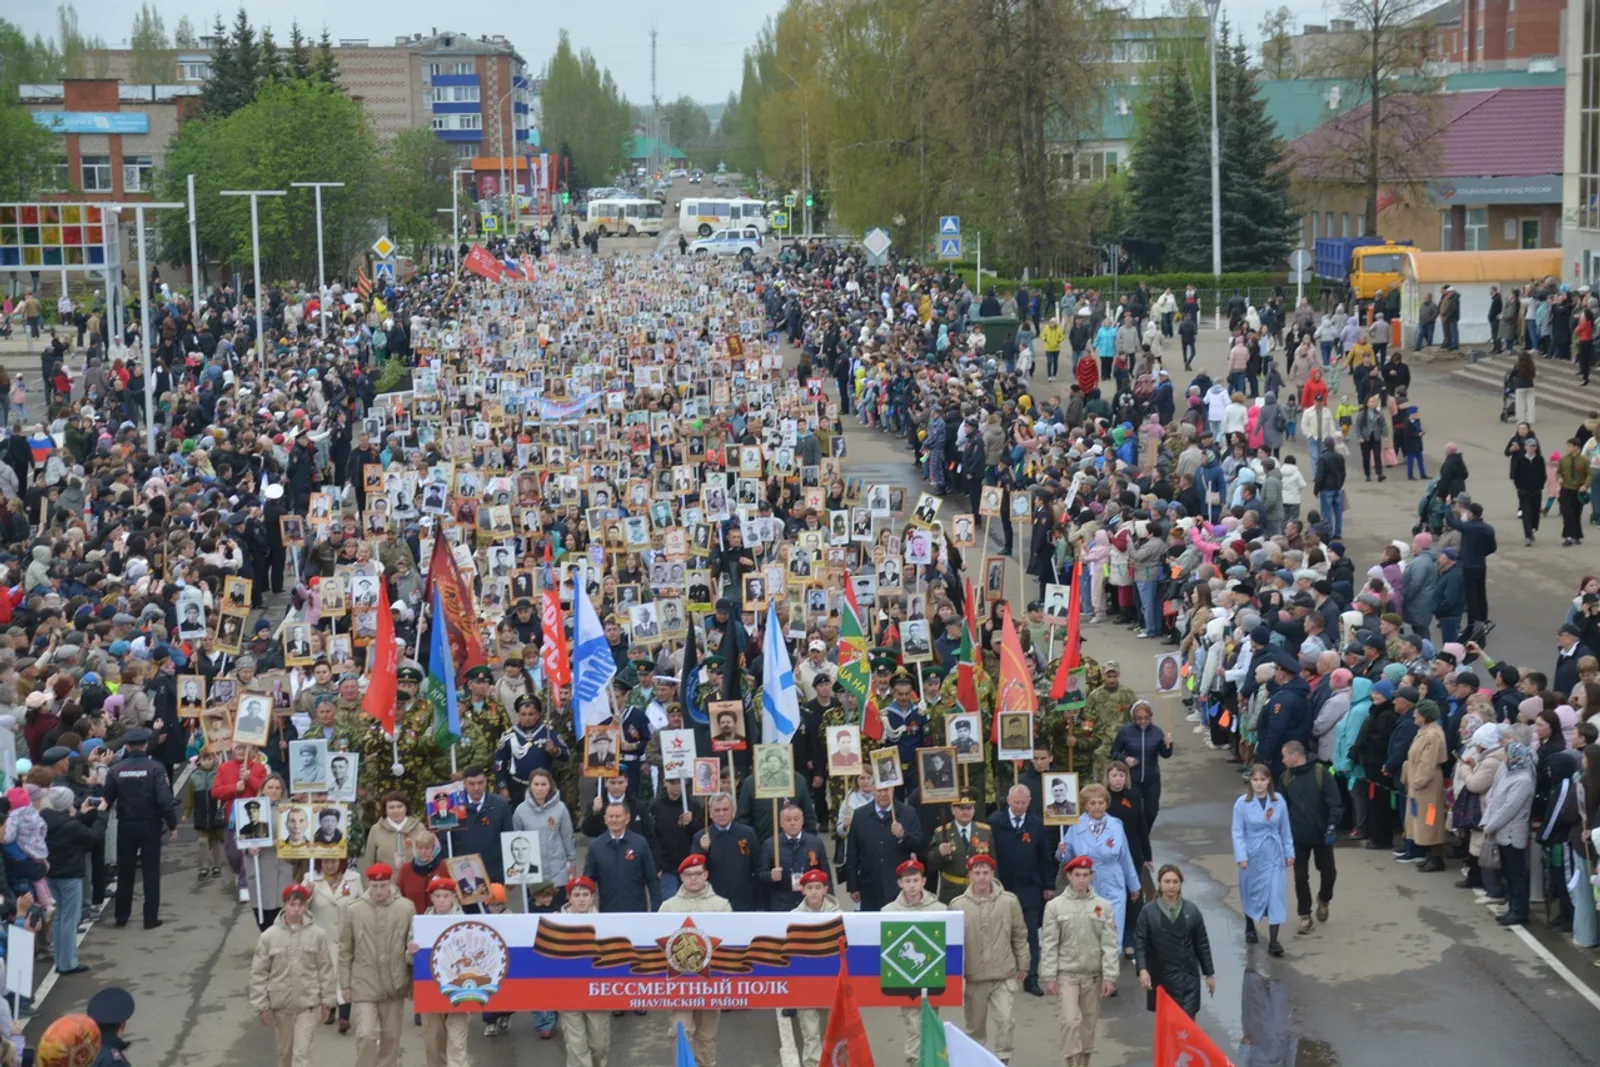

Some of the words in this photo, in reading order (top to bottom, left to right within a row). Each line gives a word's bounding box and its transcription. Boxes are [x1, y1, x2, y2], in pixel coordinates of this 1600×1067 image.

[588, 979, 732, 996] БЕССМЕРТНЫЙ
[737, 980, 789, 995] ПОЛК
[629, 997, 706, 1009] ЯНАУЛЬСКИЙ
[710, 996, 748, 1007] РАЙОН
